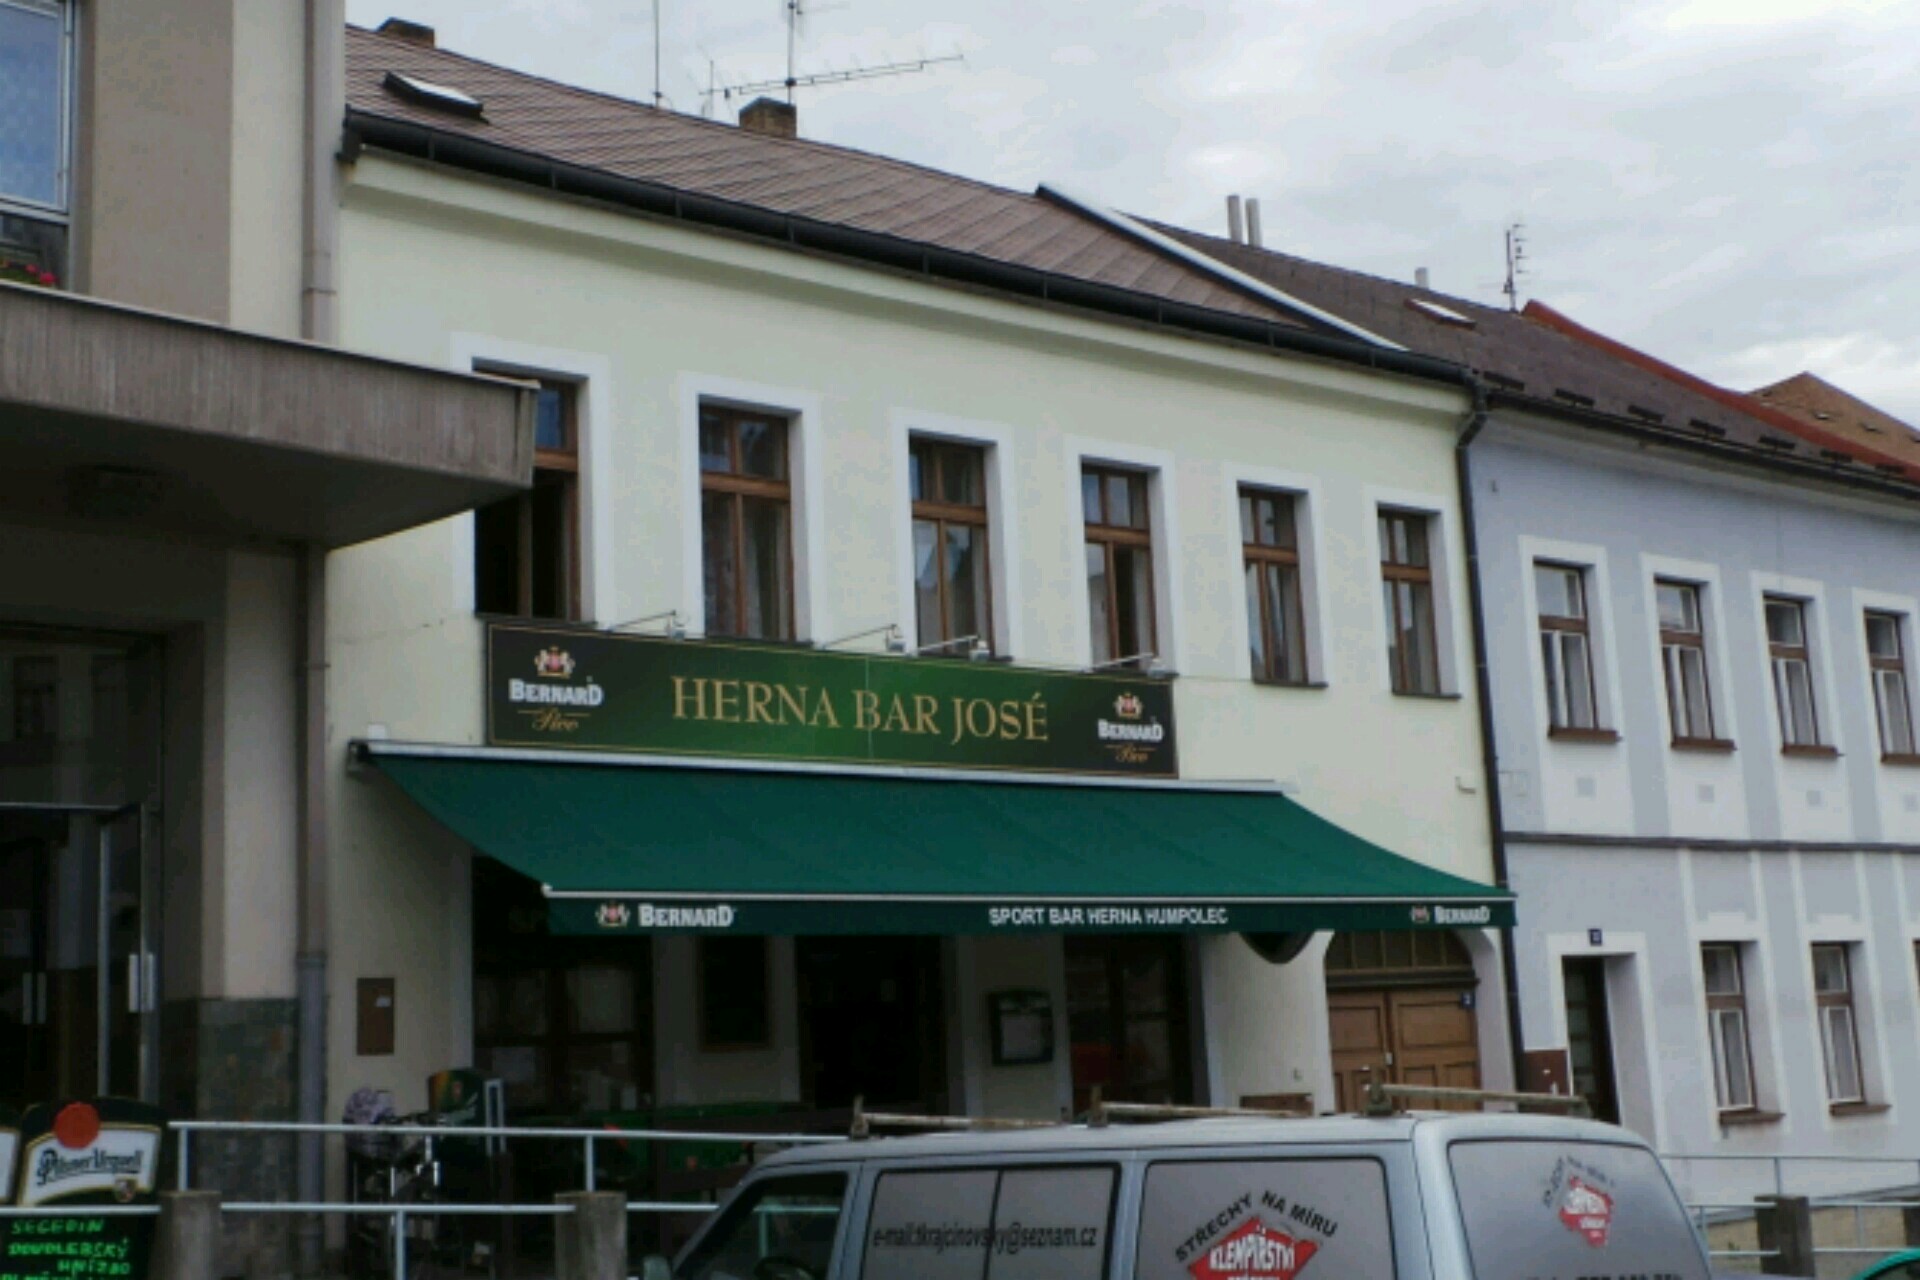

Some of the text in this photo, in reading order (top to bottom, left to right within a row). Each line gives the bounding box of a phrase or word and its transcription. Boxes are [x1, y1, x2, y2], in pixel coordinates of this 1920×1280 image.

[508, 678, 604, 706] BERNARD
[671, 676, 1049, 745] HERNA BAR JOSÉ
[1097, 718, 1164, 742] BERNARD
[638, 902, 734, 927] BERNARD
[988, 907, 1228, 926] SPORT BAR HERNA HUMPOLEC
[1434, 905, 1490, 924] BERNARD
[1261, 1190, 1287, 1214] NA
[1289, 1204, 1338, 1238] MÍRU
